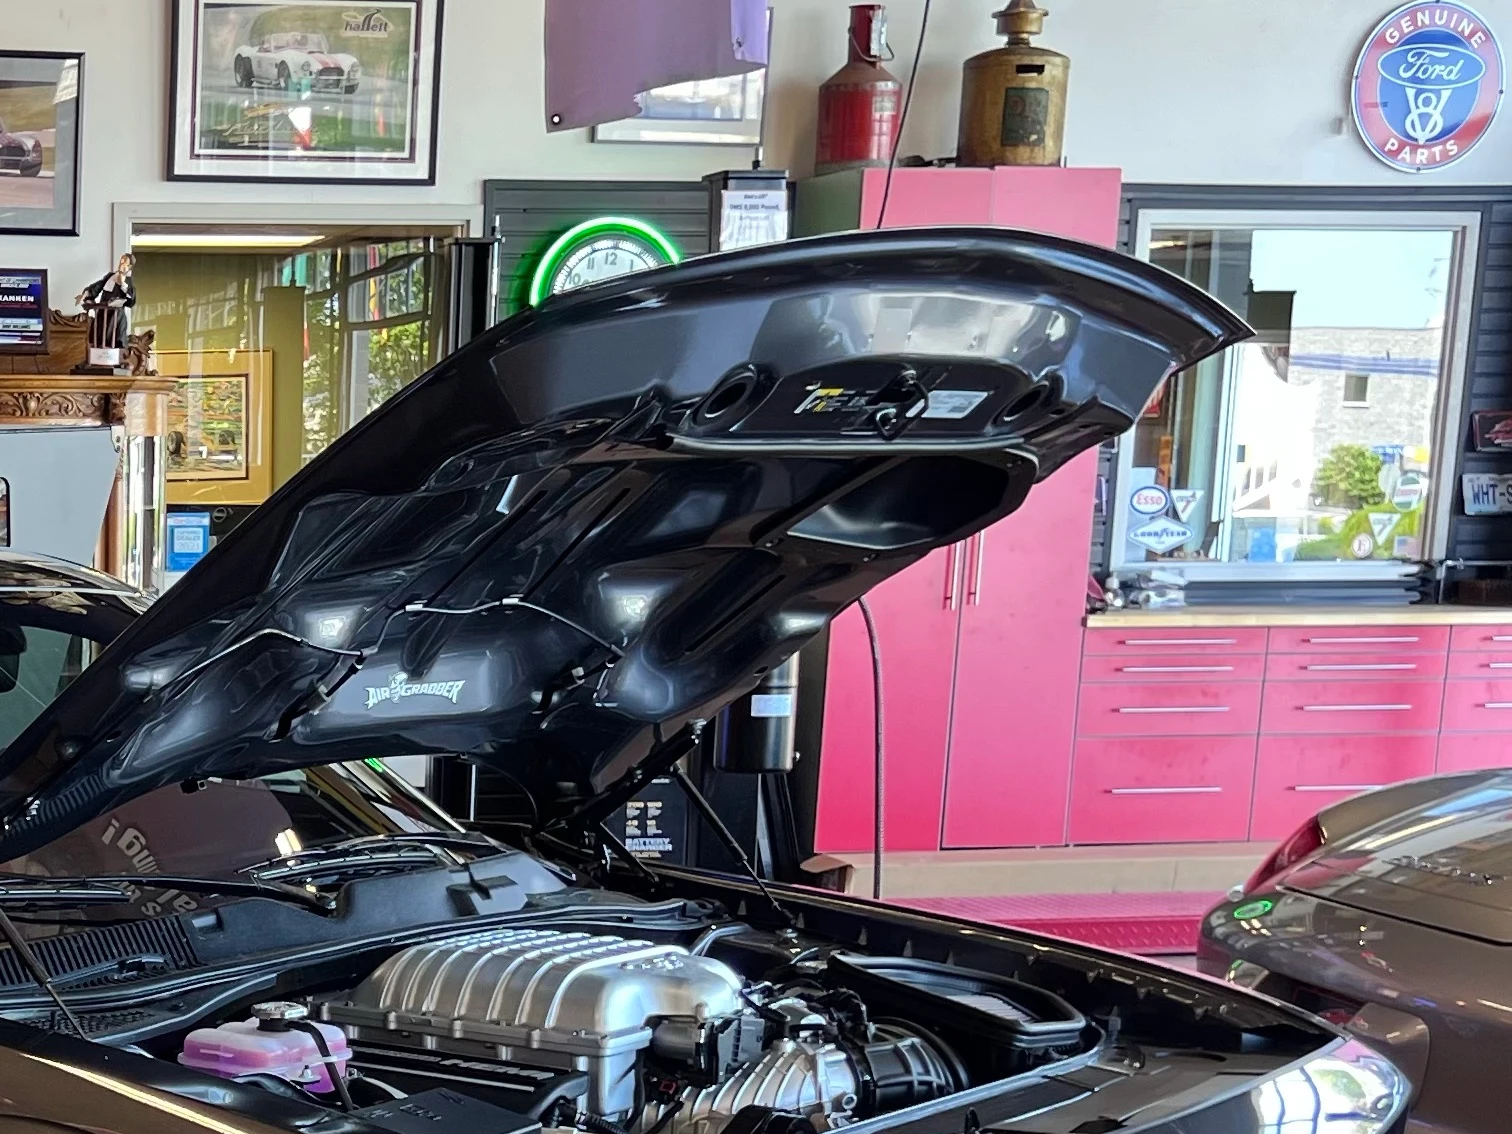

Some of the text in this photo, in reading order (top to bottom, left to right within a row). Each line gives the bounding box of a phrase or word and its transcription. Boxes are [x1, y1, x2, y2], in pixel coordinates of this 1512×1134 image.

[1385, 9, 1486, 49] GENUINE
[1399, 48, 1465, 80] Ford
[1384, 138, 1459, 165] PARTS
[604, 252, 618, 266] 12
[364, 687, 390, 709] AIR
